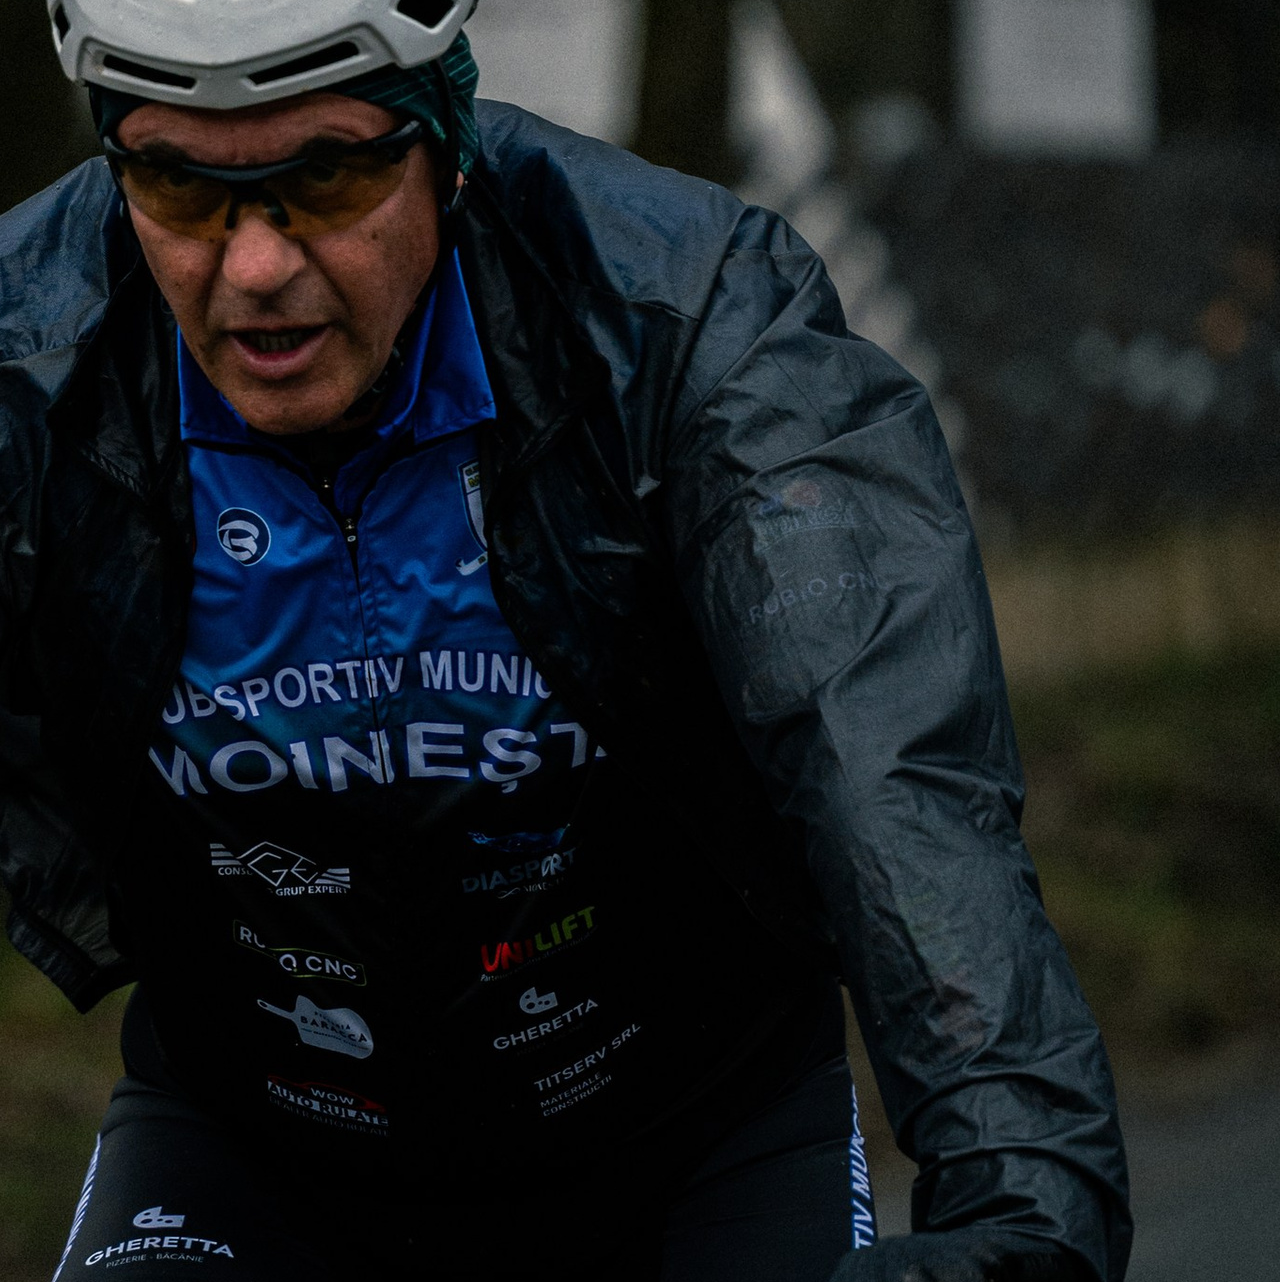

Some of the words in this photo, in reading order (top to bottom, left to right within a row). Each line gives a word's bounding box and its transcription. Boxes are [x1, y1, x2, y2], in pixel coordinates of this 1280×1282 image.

[147, 721, 608, 797] MOINEȘT
[274, 885, 306, 897] GRUP
[304, 955, 358, 980] CNC
[300, 1015, 368, 1043] BARACCA
[492, 998, 600, 1050] GHERETTA
[533, 1046, 607, 1093] TITSERV
[611, 1022, 642, 1050] SRL
[309, 1086, 355, 1106] WOW
[539, 1071, 603, 1109] MATERIALE
[84, 1235, 235, 1266] GHERETTA
